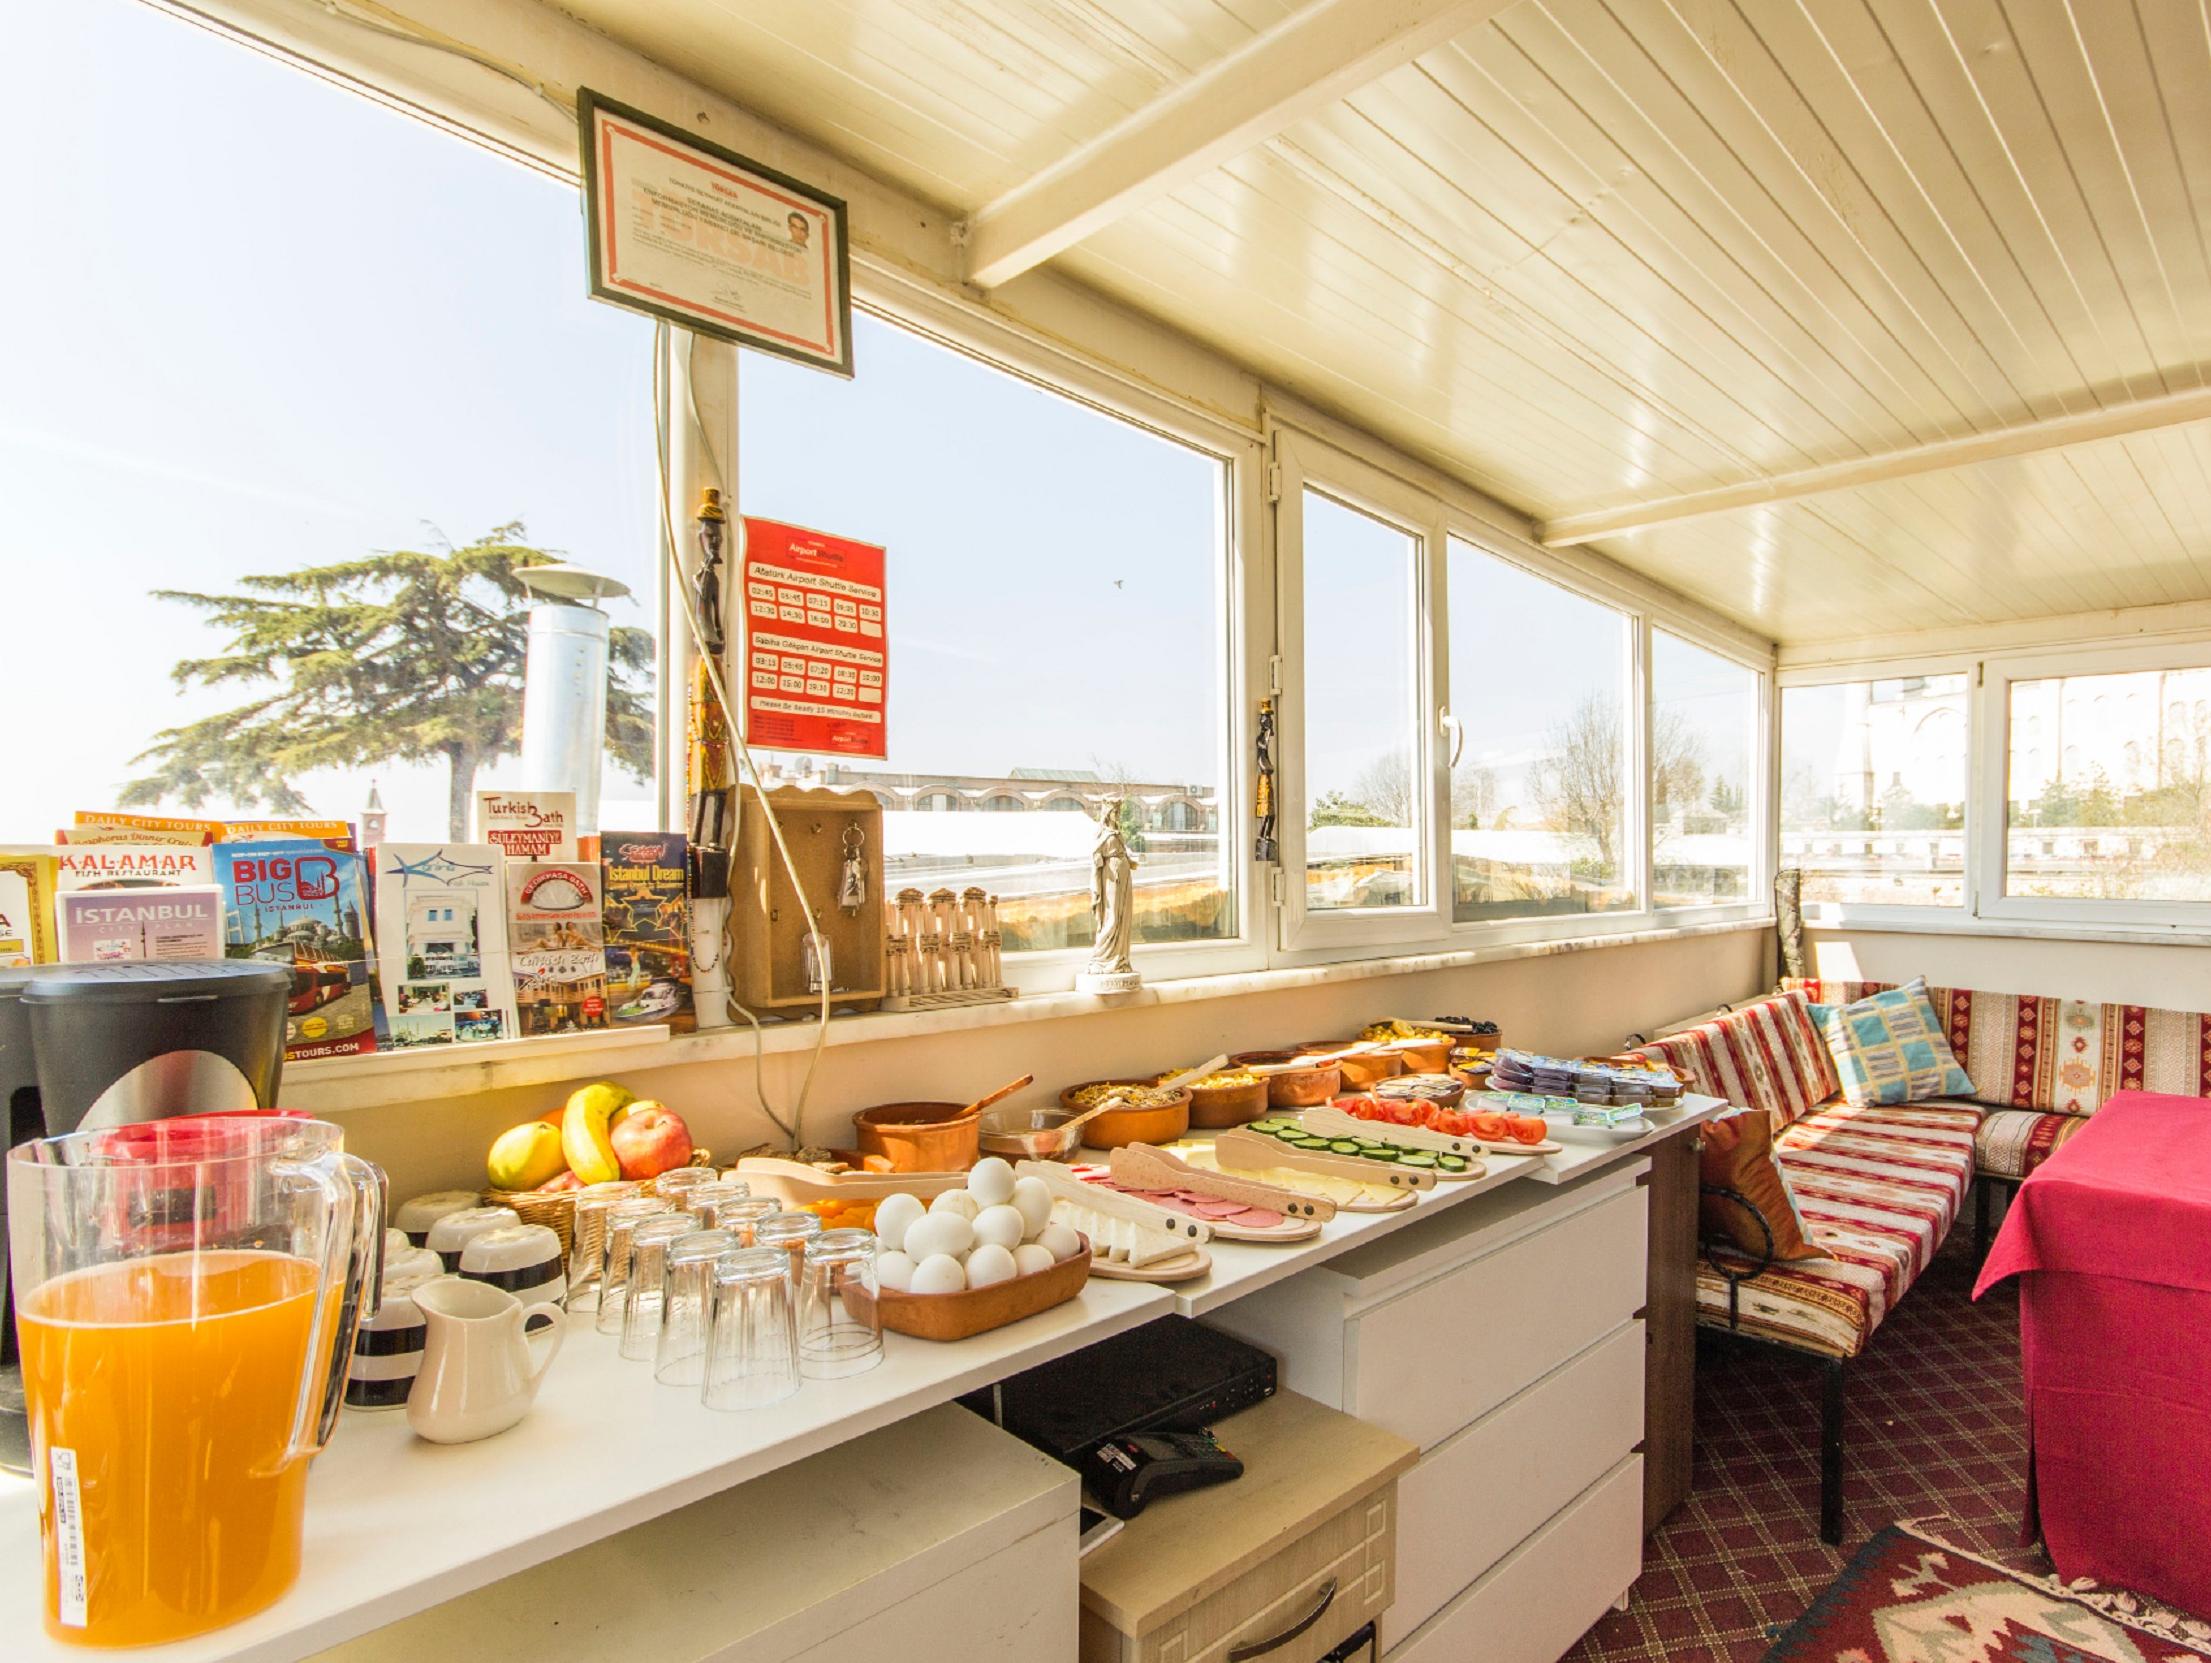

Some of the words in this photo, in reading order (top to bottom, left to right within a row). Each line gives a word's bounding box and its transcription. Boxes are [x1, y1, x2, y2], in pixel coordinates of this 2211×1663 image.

[787, 571, 817, 587] Airport
[819, 577, 847, 591] Shuttle
[848, 584, 877, 599] Service
[811, 645, 834, 658] Airport
[835, 649, 857, 661] Shuttle
[858, 653, 882, 665] Service
[483, 796, 536, 815] Turkish
[85, 815, 127, 827] DAILY
[131, 818, 163, 830] CITY
[167, 821, 212, 832] TOURS
[225, 823, 266, 835] DAILY
[268, 822, 296, 833] CITY
[299, 820, 338, 831] TOURS
[130, 832, 166, 843] Dinner
[506, 844, 547, 856] HAMAM
[75, 870, 103, 878] FISH
[106, 869, 182, 878] RESTAURANT
[232, 857, 292, 883] BIG
[652, 865, 684, 881] Dream
[235, 882, 296, 906] BUS
[99, 925, 135, 934] CITY
[153, 922, 194, 931] PLAN
